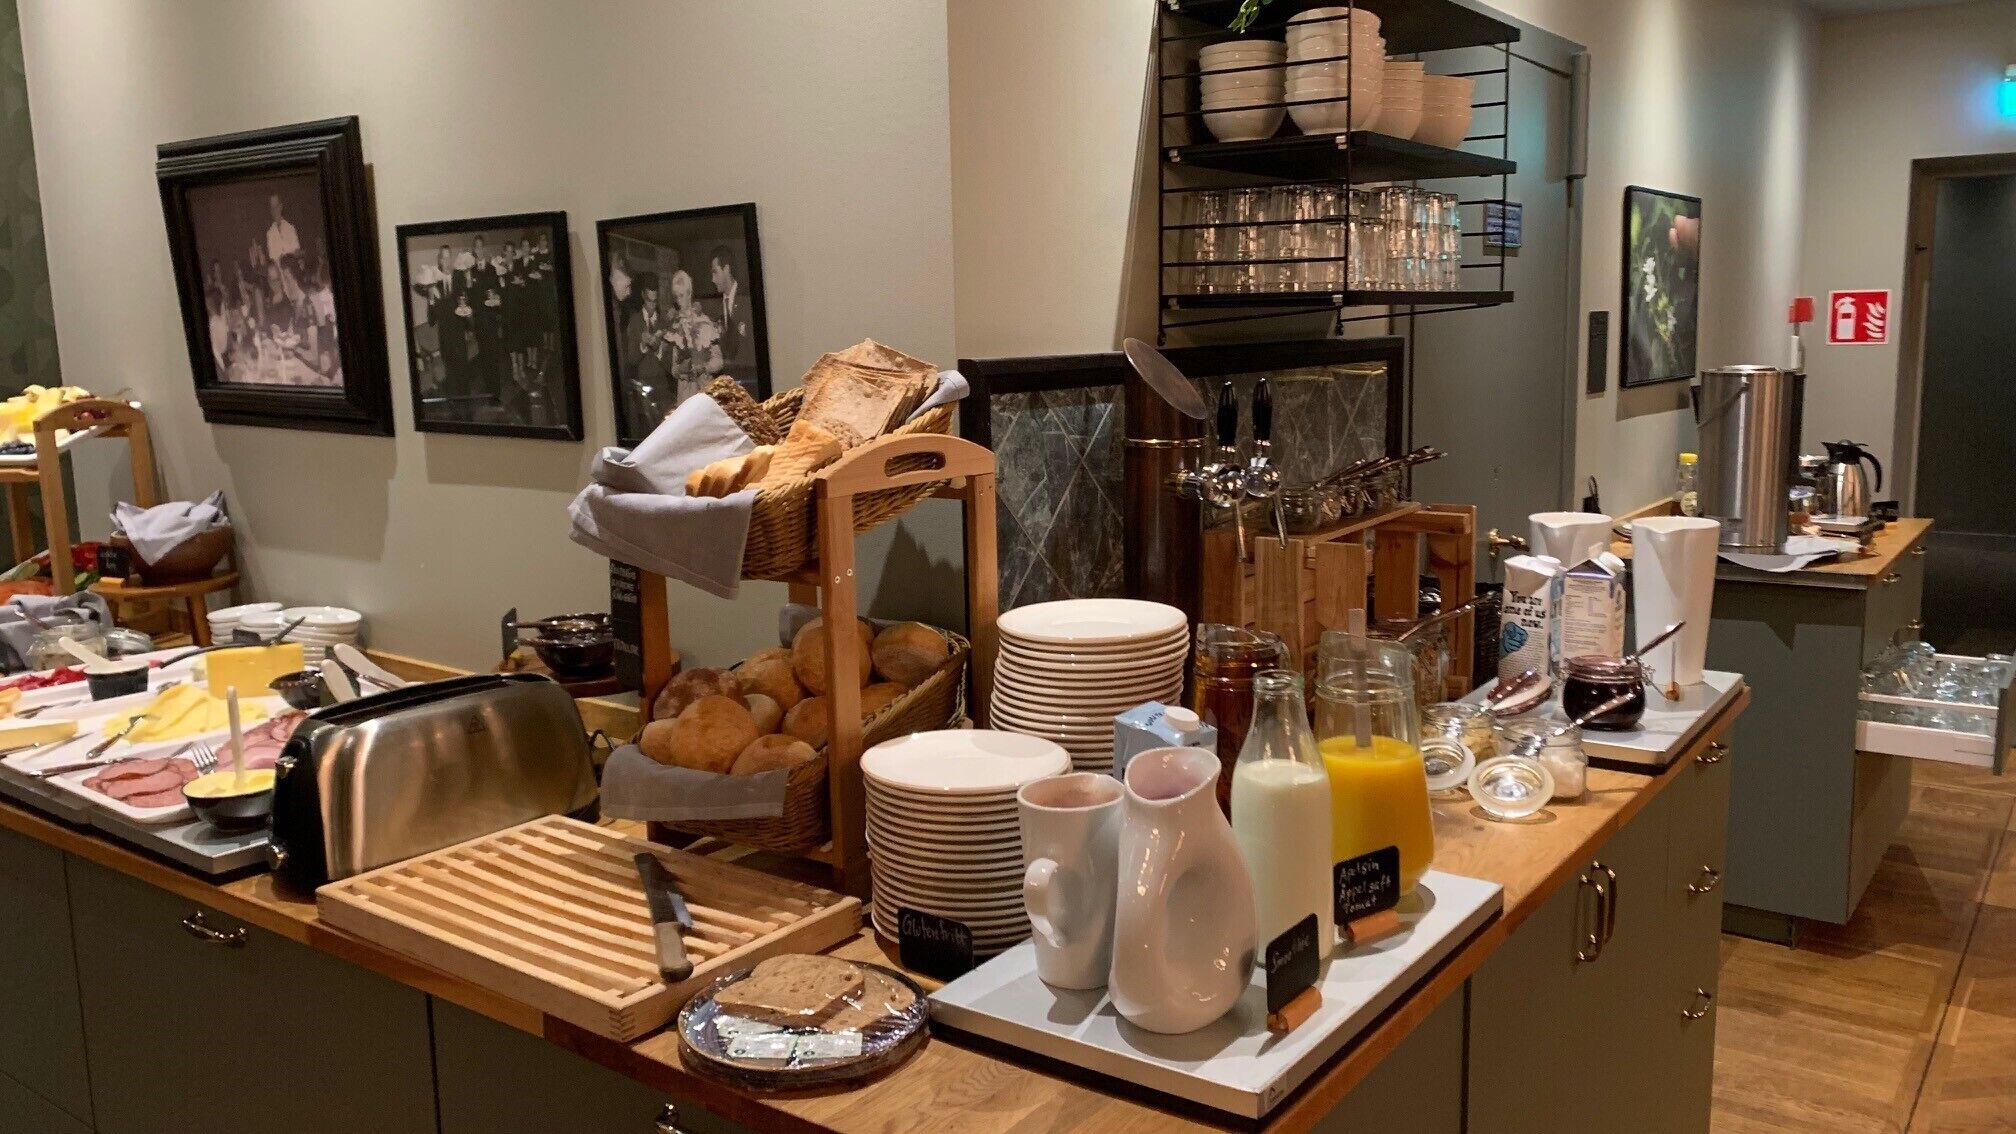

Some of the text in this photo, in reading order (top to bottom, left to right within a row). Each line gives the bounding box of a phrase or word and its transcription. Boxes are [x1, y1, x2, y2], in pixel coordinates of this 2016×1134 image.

[1509, 590, 1526, 604] You
[1523, 605, 1534, 616] of
[1535, 609, 1547, 619] us
